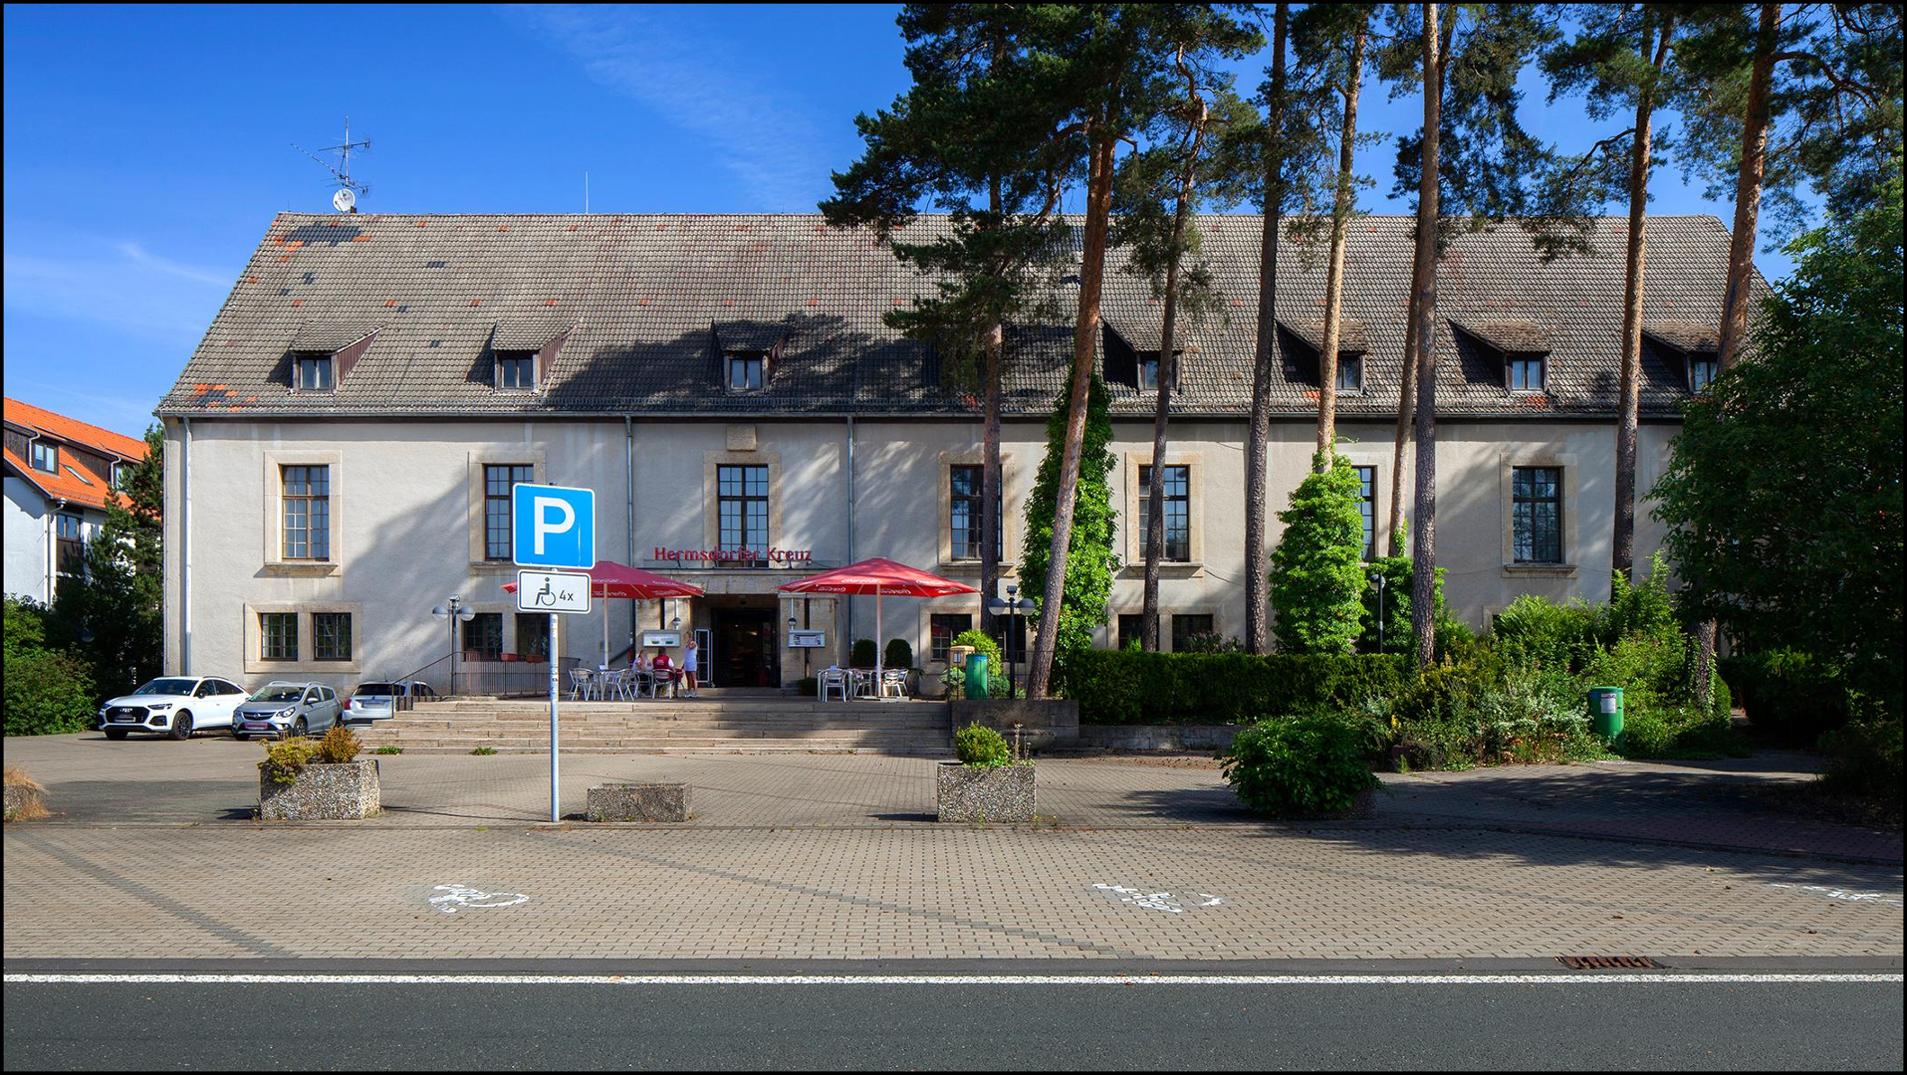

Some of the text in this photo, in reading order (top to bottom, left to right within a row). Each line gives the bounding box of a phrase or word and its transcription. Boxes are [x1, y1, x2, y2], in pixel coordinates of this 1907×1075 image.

[534, 496, 575, 555] P
[654, 546, 811, 562] Hermsdorfer Kreuz
[560, 590, 574, 601] 4x
